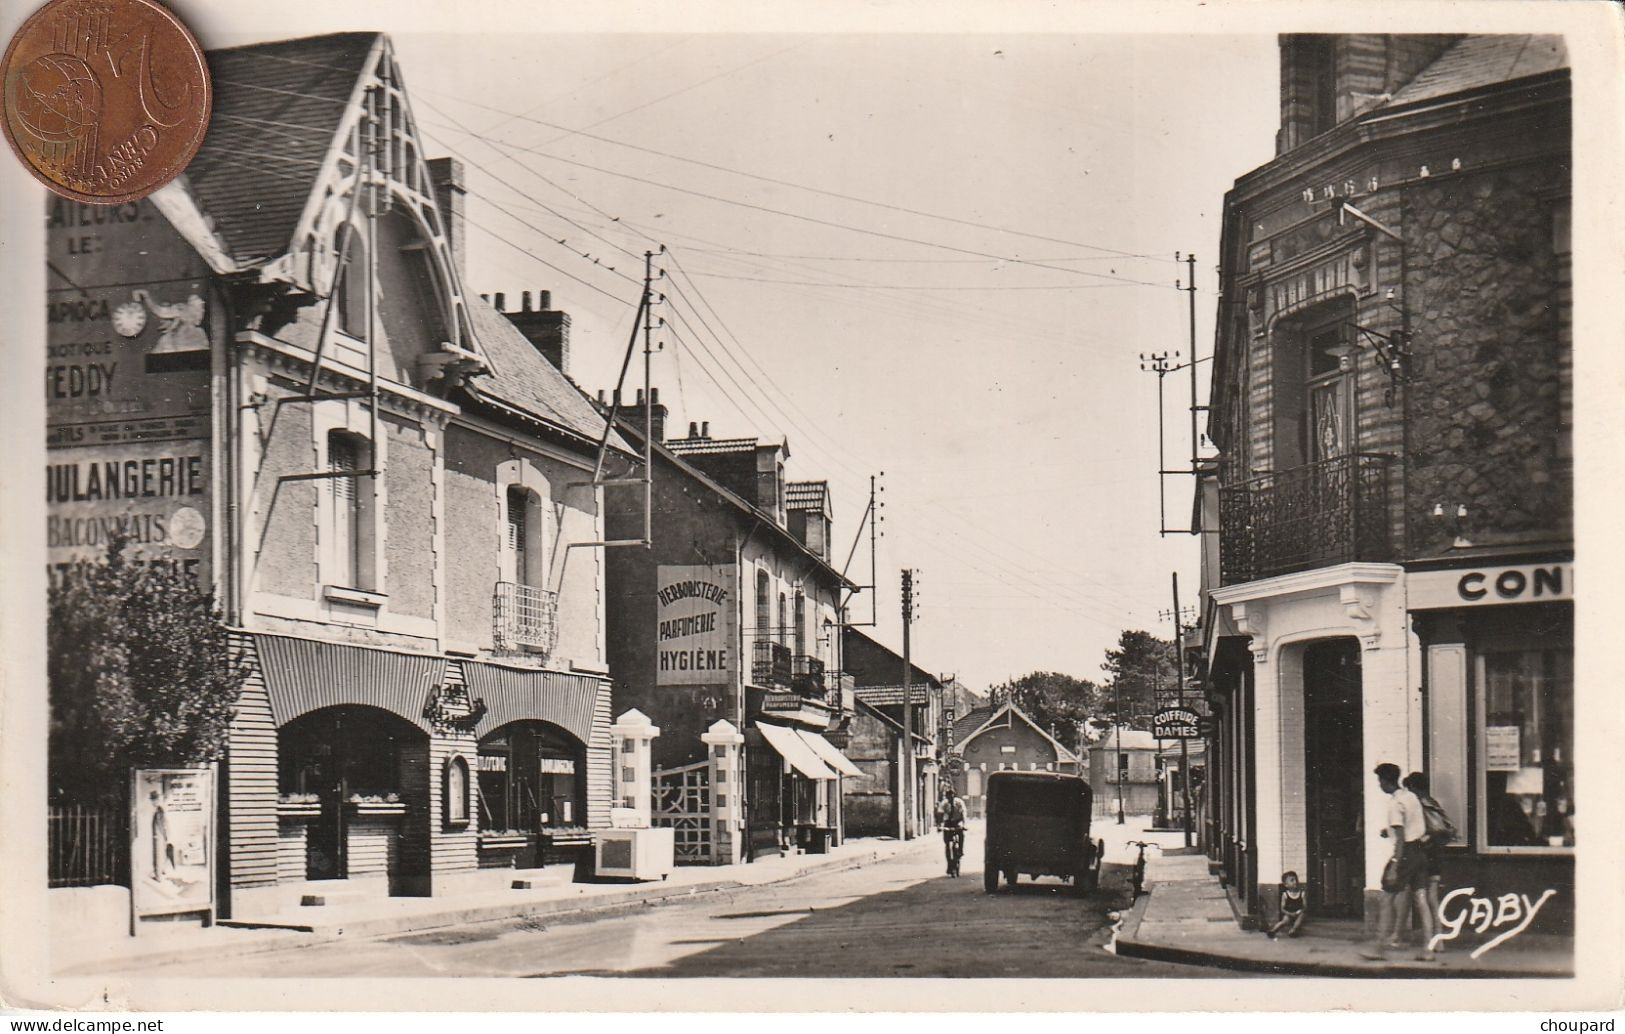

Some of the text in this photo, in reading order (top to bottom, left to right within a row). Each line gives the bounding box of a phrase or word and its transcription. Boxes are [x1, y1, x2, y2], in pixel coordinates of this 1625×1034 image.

[657, 580, 728, 607] HERBORISTERIE
[1457, 566, 1574, 602] CON
[659, 611, 717, 642] PARFUMERIE
[660, 647, 727, 671] HYGIÈNE
[1154, 710, 1199, 726] COIFFURE
[1155, 726, 1198, 737] DAMES
[946, 711, 954, 757] GARAG
